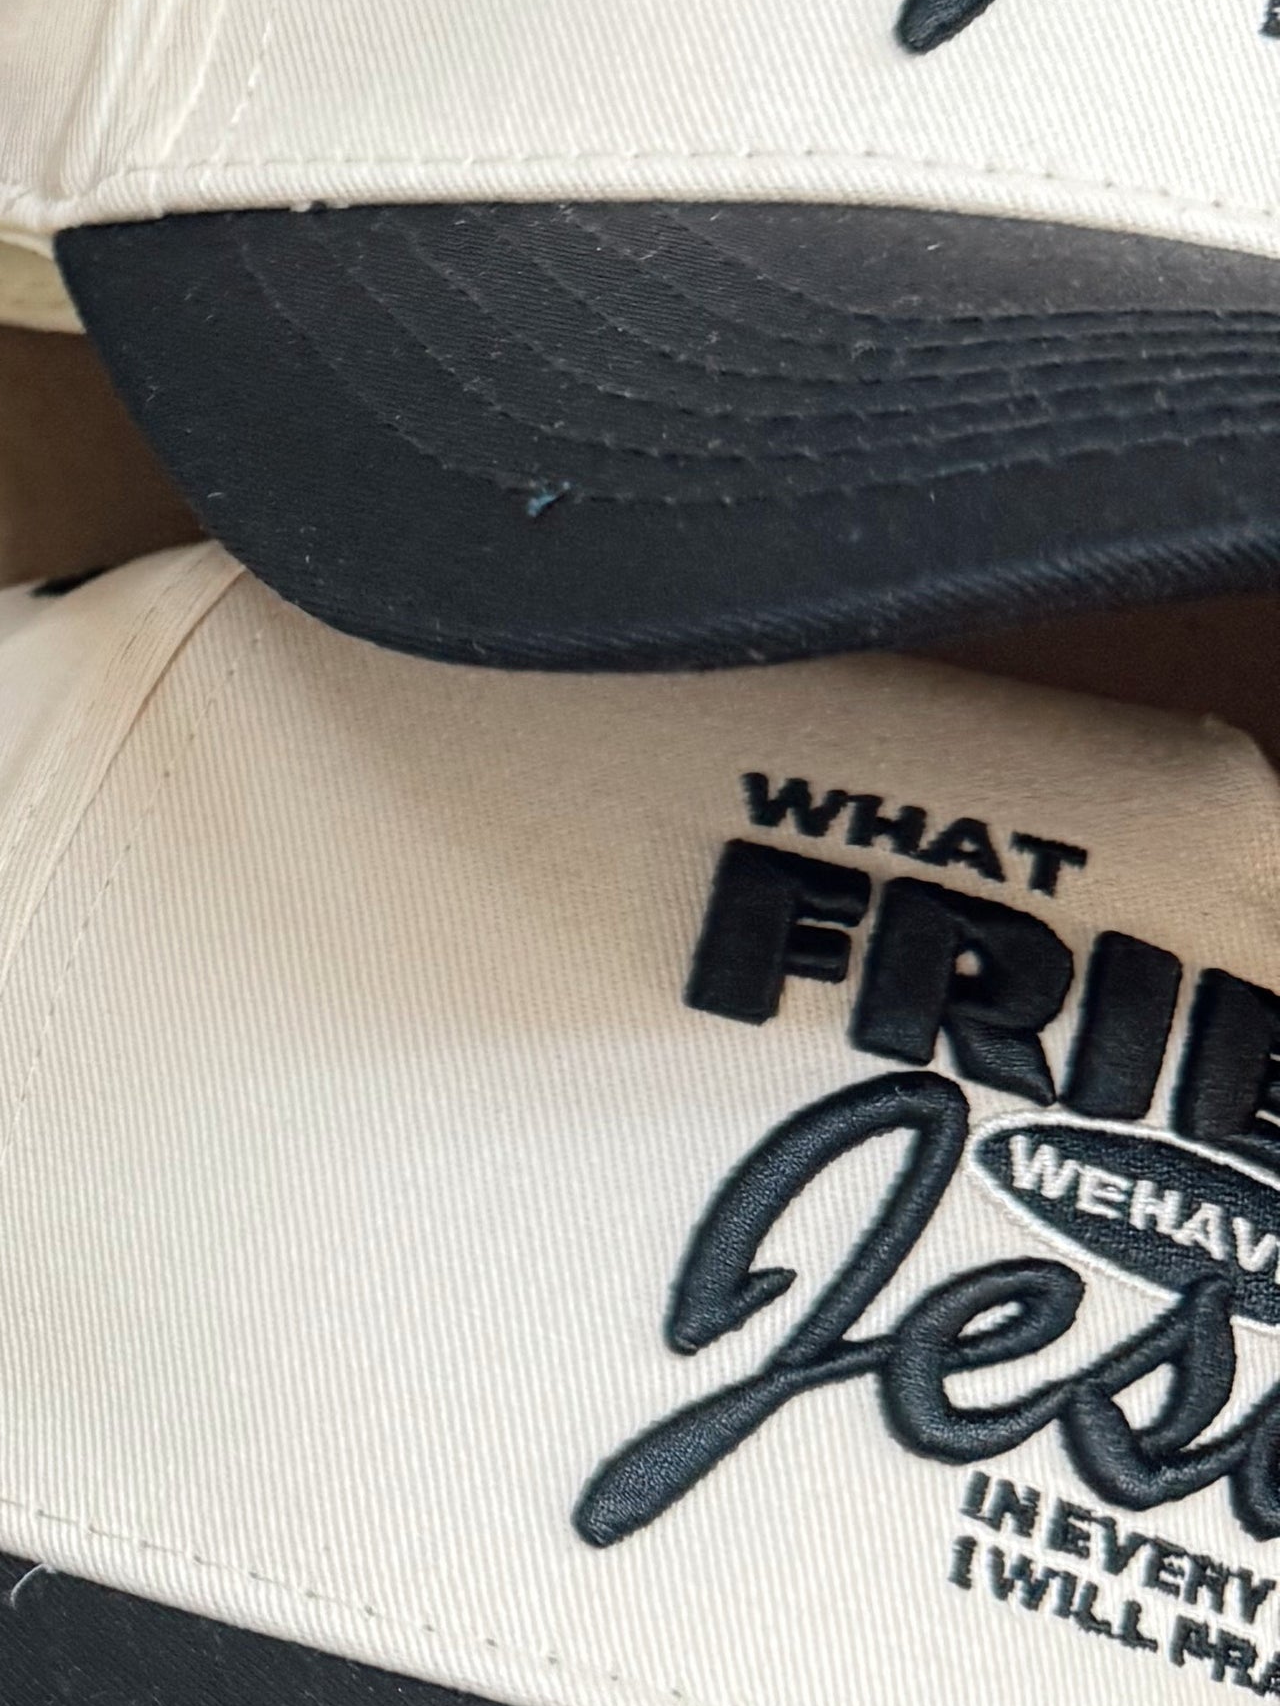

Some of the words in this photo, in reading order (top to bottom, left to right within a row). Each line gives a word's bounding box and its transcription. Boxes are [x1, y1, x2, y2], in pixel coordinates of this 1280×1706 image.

[741, 771, 1088, 897] WHAT
[572, 1071, 1280, 1549] Jes
[947, 1534, 978, 1592] I
[987, 1544, 1159, 1653] WILL
[959, 1470, 1041, 1538] IN
[1044, 1497, 1277, 1625] EVERY
